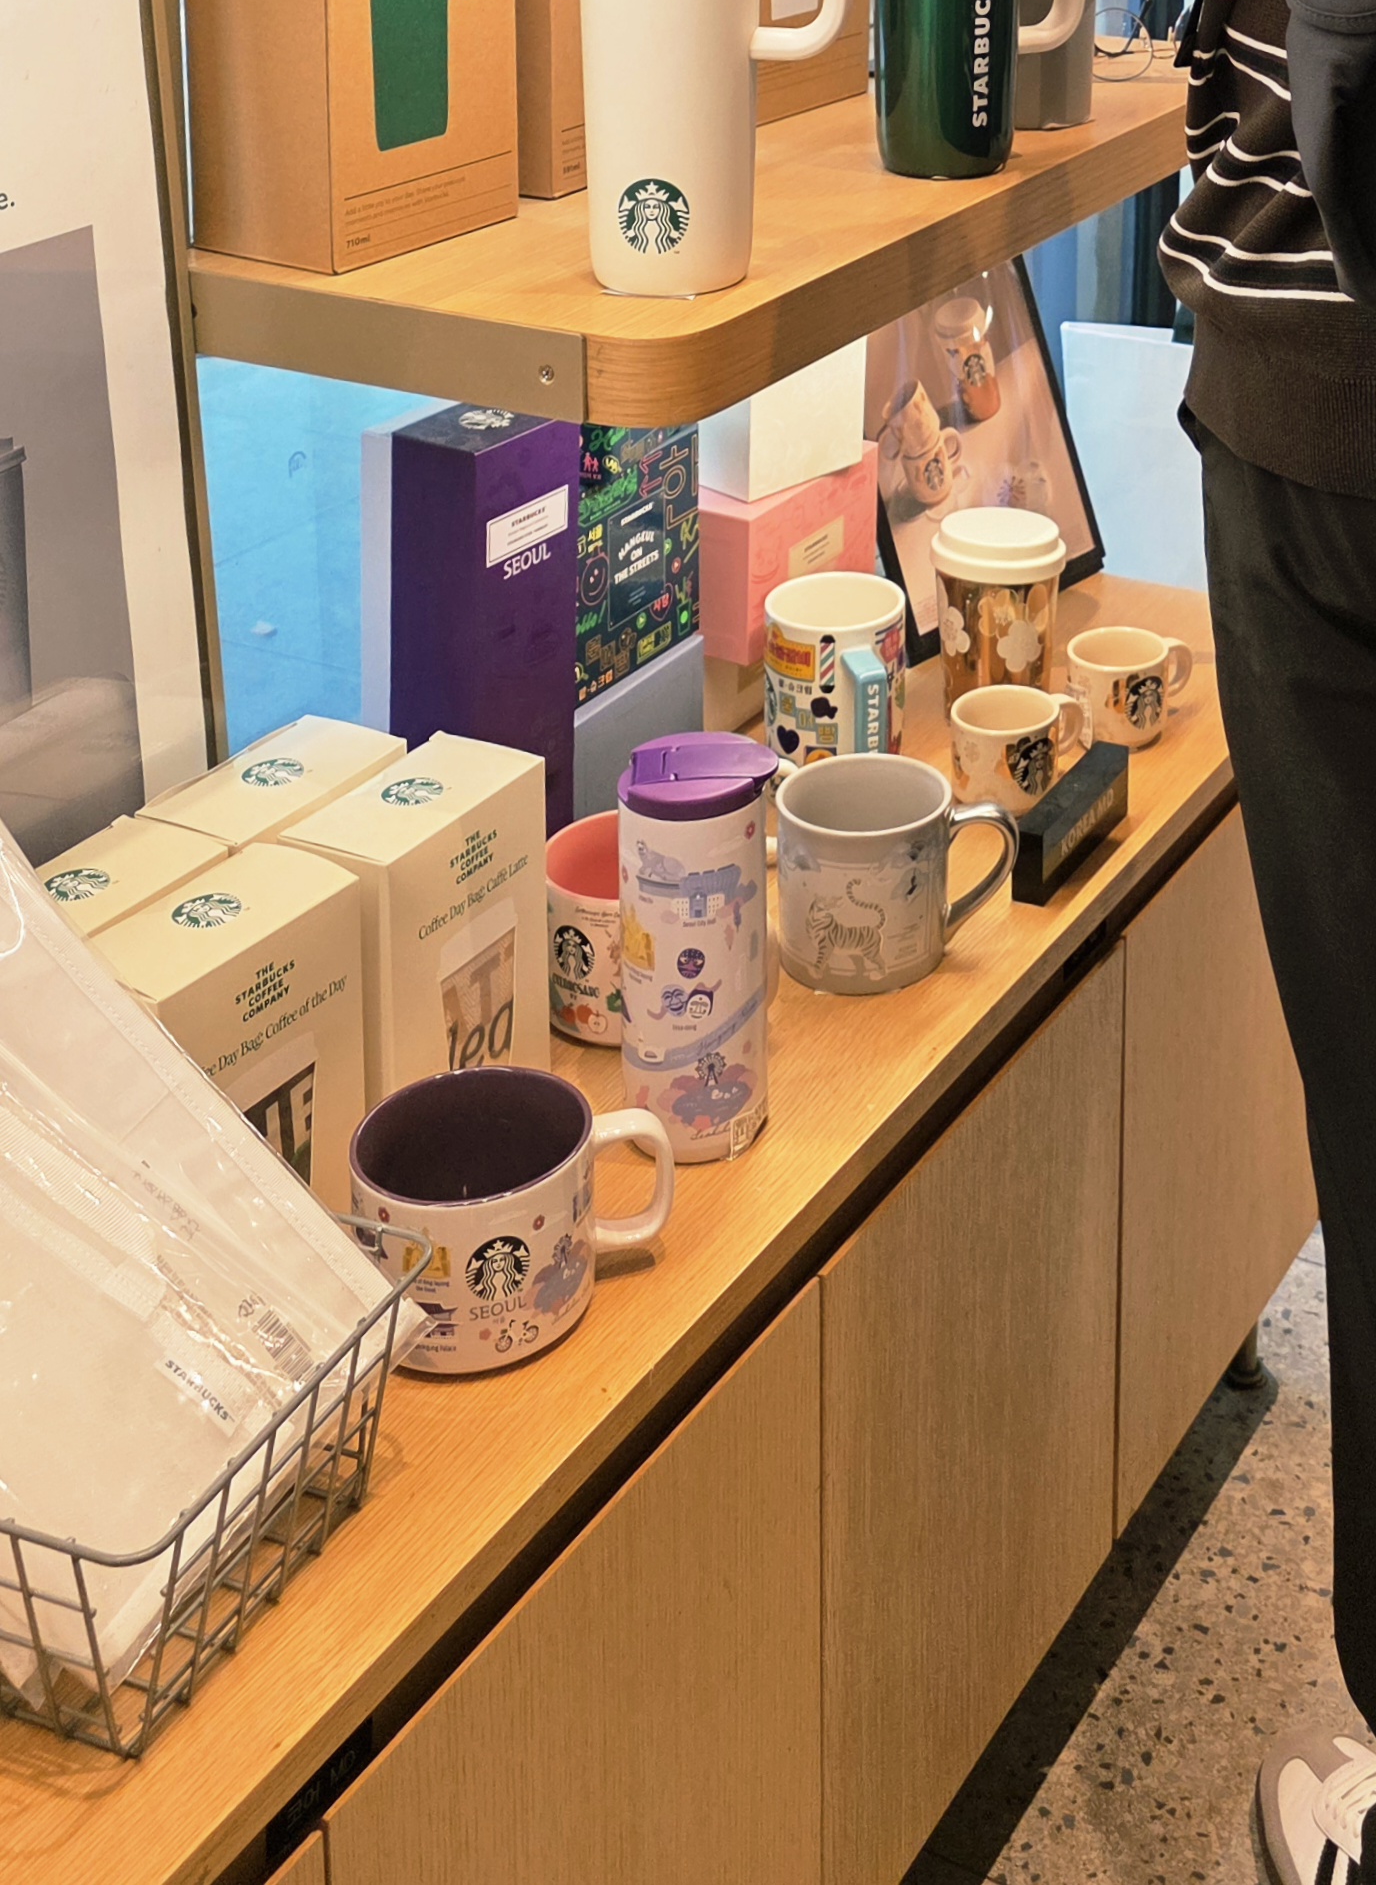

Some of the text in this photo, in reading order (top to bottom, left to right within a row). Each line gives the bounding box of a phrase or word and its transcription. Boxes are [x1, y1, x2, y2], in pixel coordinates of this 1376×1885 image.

[346, 233, 372, 249] 710ml
[511, 506, 547, 527] STARBUCKS
[503, 543, 551, 580] SEOUL
[630, 546, 643, 561] ON
[614, 569, 629, 585] THE
[867, 684, 879, 753] STARB
[450, 829, 498, 868] STARBUCKS
[465, 829, 481, 846] THE
[455, 853, 494, 885] COMPANY
[460, 846, 489, 871] COFFEE
[418, 914, 448, 941] Coffee
[449, 900, 466, 920] Day
[508, 854, 529, 876] Latte
[235, 959, 296, 1005] STARBUCKS
[255, 961, 275, 980] THE
[242, 985, 291, 1023] COMPANY
[248, 978, 284, 1007] COFFEE
[218, 1050, 239, 1071] Day
[265, 1010, 298, 1039] Coffee
[298, 999, 310, 1017] of
[311, 988, 328, 1008] the
[328, 975, 348, 997] Day
[469, 1296, 526, 1322] SEOUL
